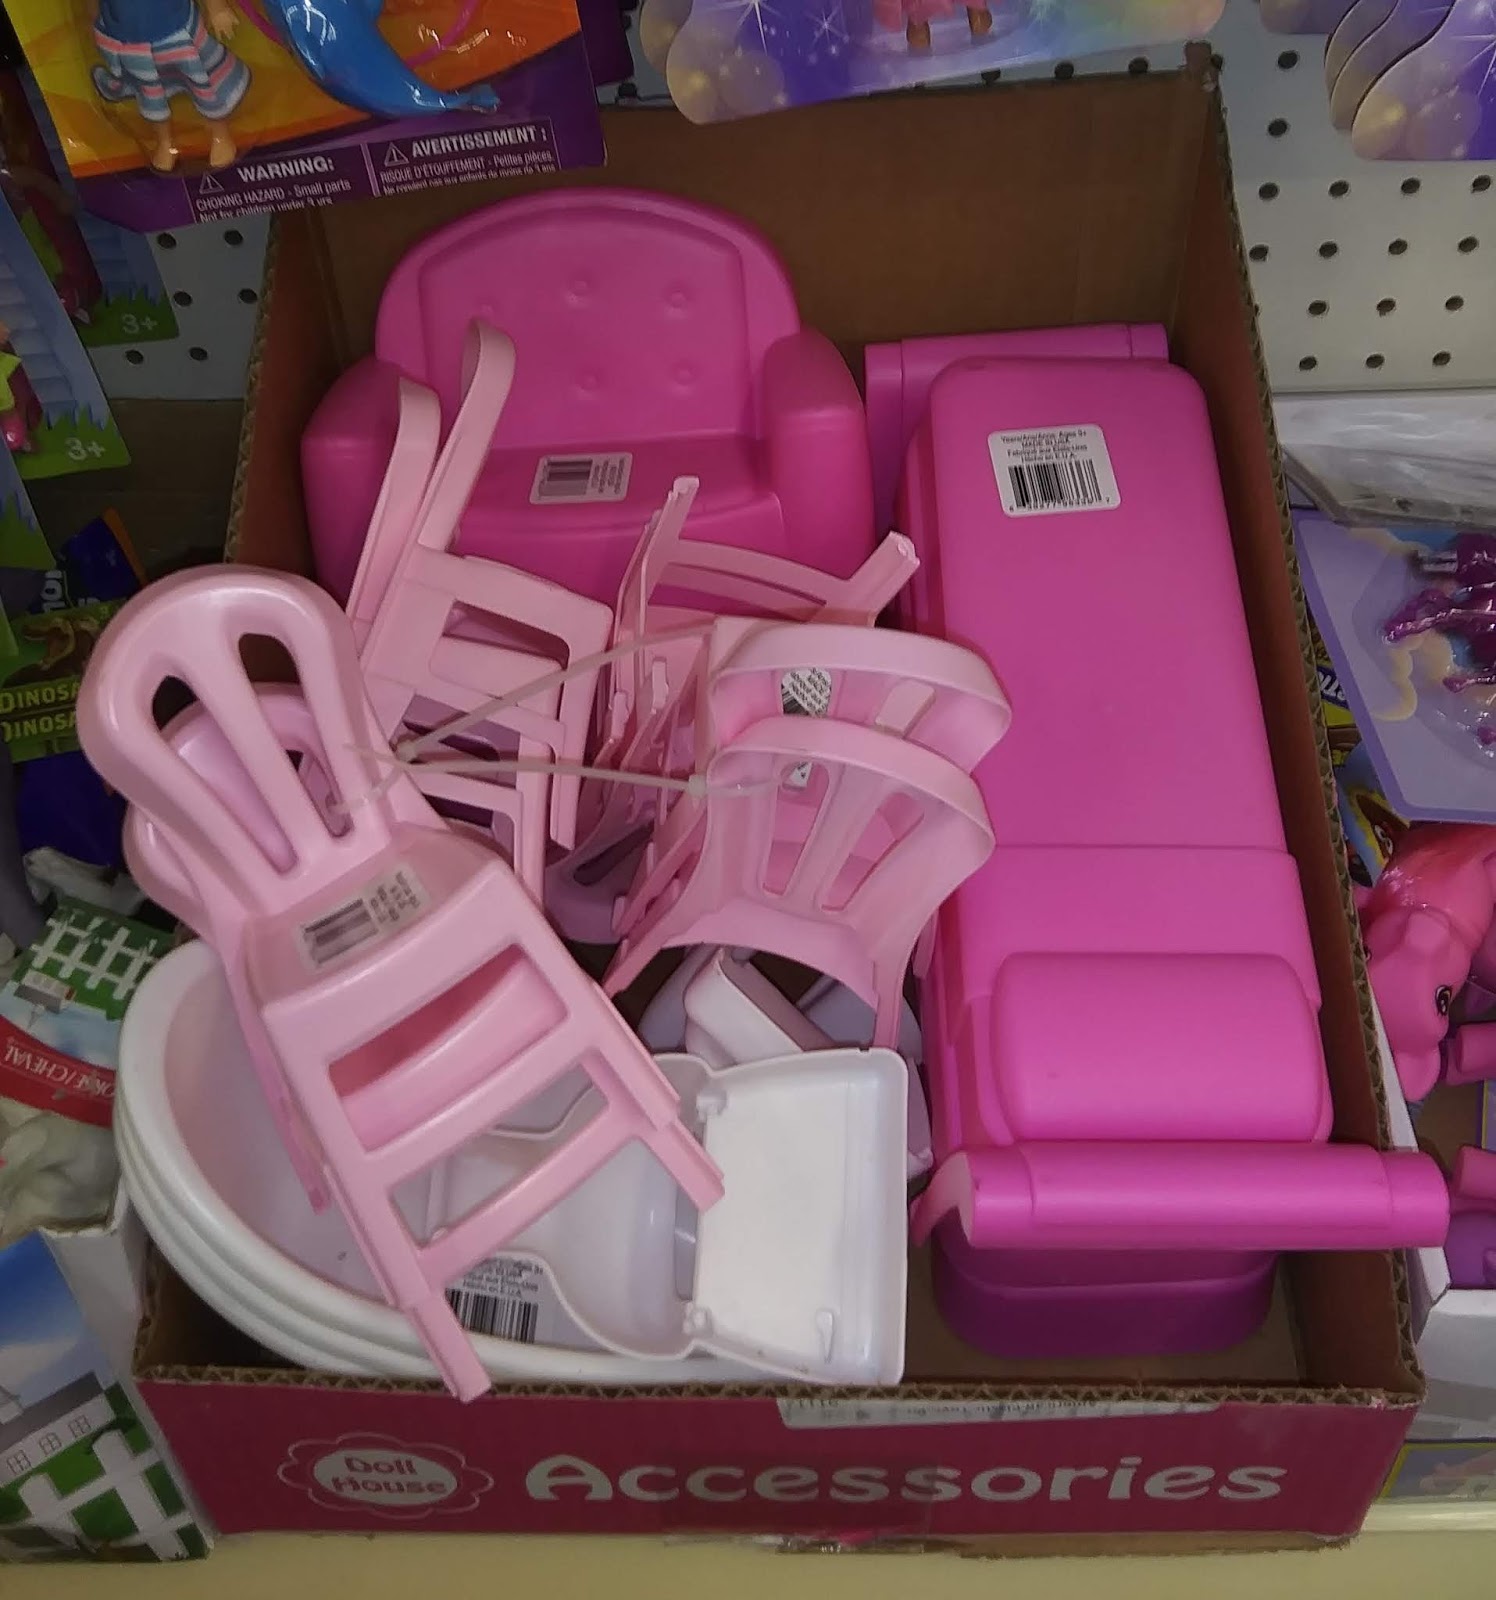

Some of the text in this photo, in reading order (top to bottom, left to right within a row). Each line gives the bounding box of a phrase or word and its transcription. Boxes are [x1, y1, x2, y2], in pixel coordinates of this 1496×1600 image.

[411, 125, 537, 158] AVERTISSEMENT
[237, 156, 335, 183] WARNING:
[380, 166, 413, 184] RISQUE
[196, 192, 243, 212] CHOKING
[244, 186, 285, 204] HAZARD
[293, 181, 323, 199] Small
[324, 178, 352, 197] parts
[200, 211, 217, 224] Not
[122, 313, 158, 334] 3+
[65, 436, 105, 461] 3+
[0, 682, 80, 714] DINOSA
[1, 711, 76, 743] DINOS
[344, 1456, 418, 1476] Doll
[525, 1454, 1288, 1503] Accessories
[331, 1475, 448, 1495] House
